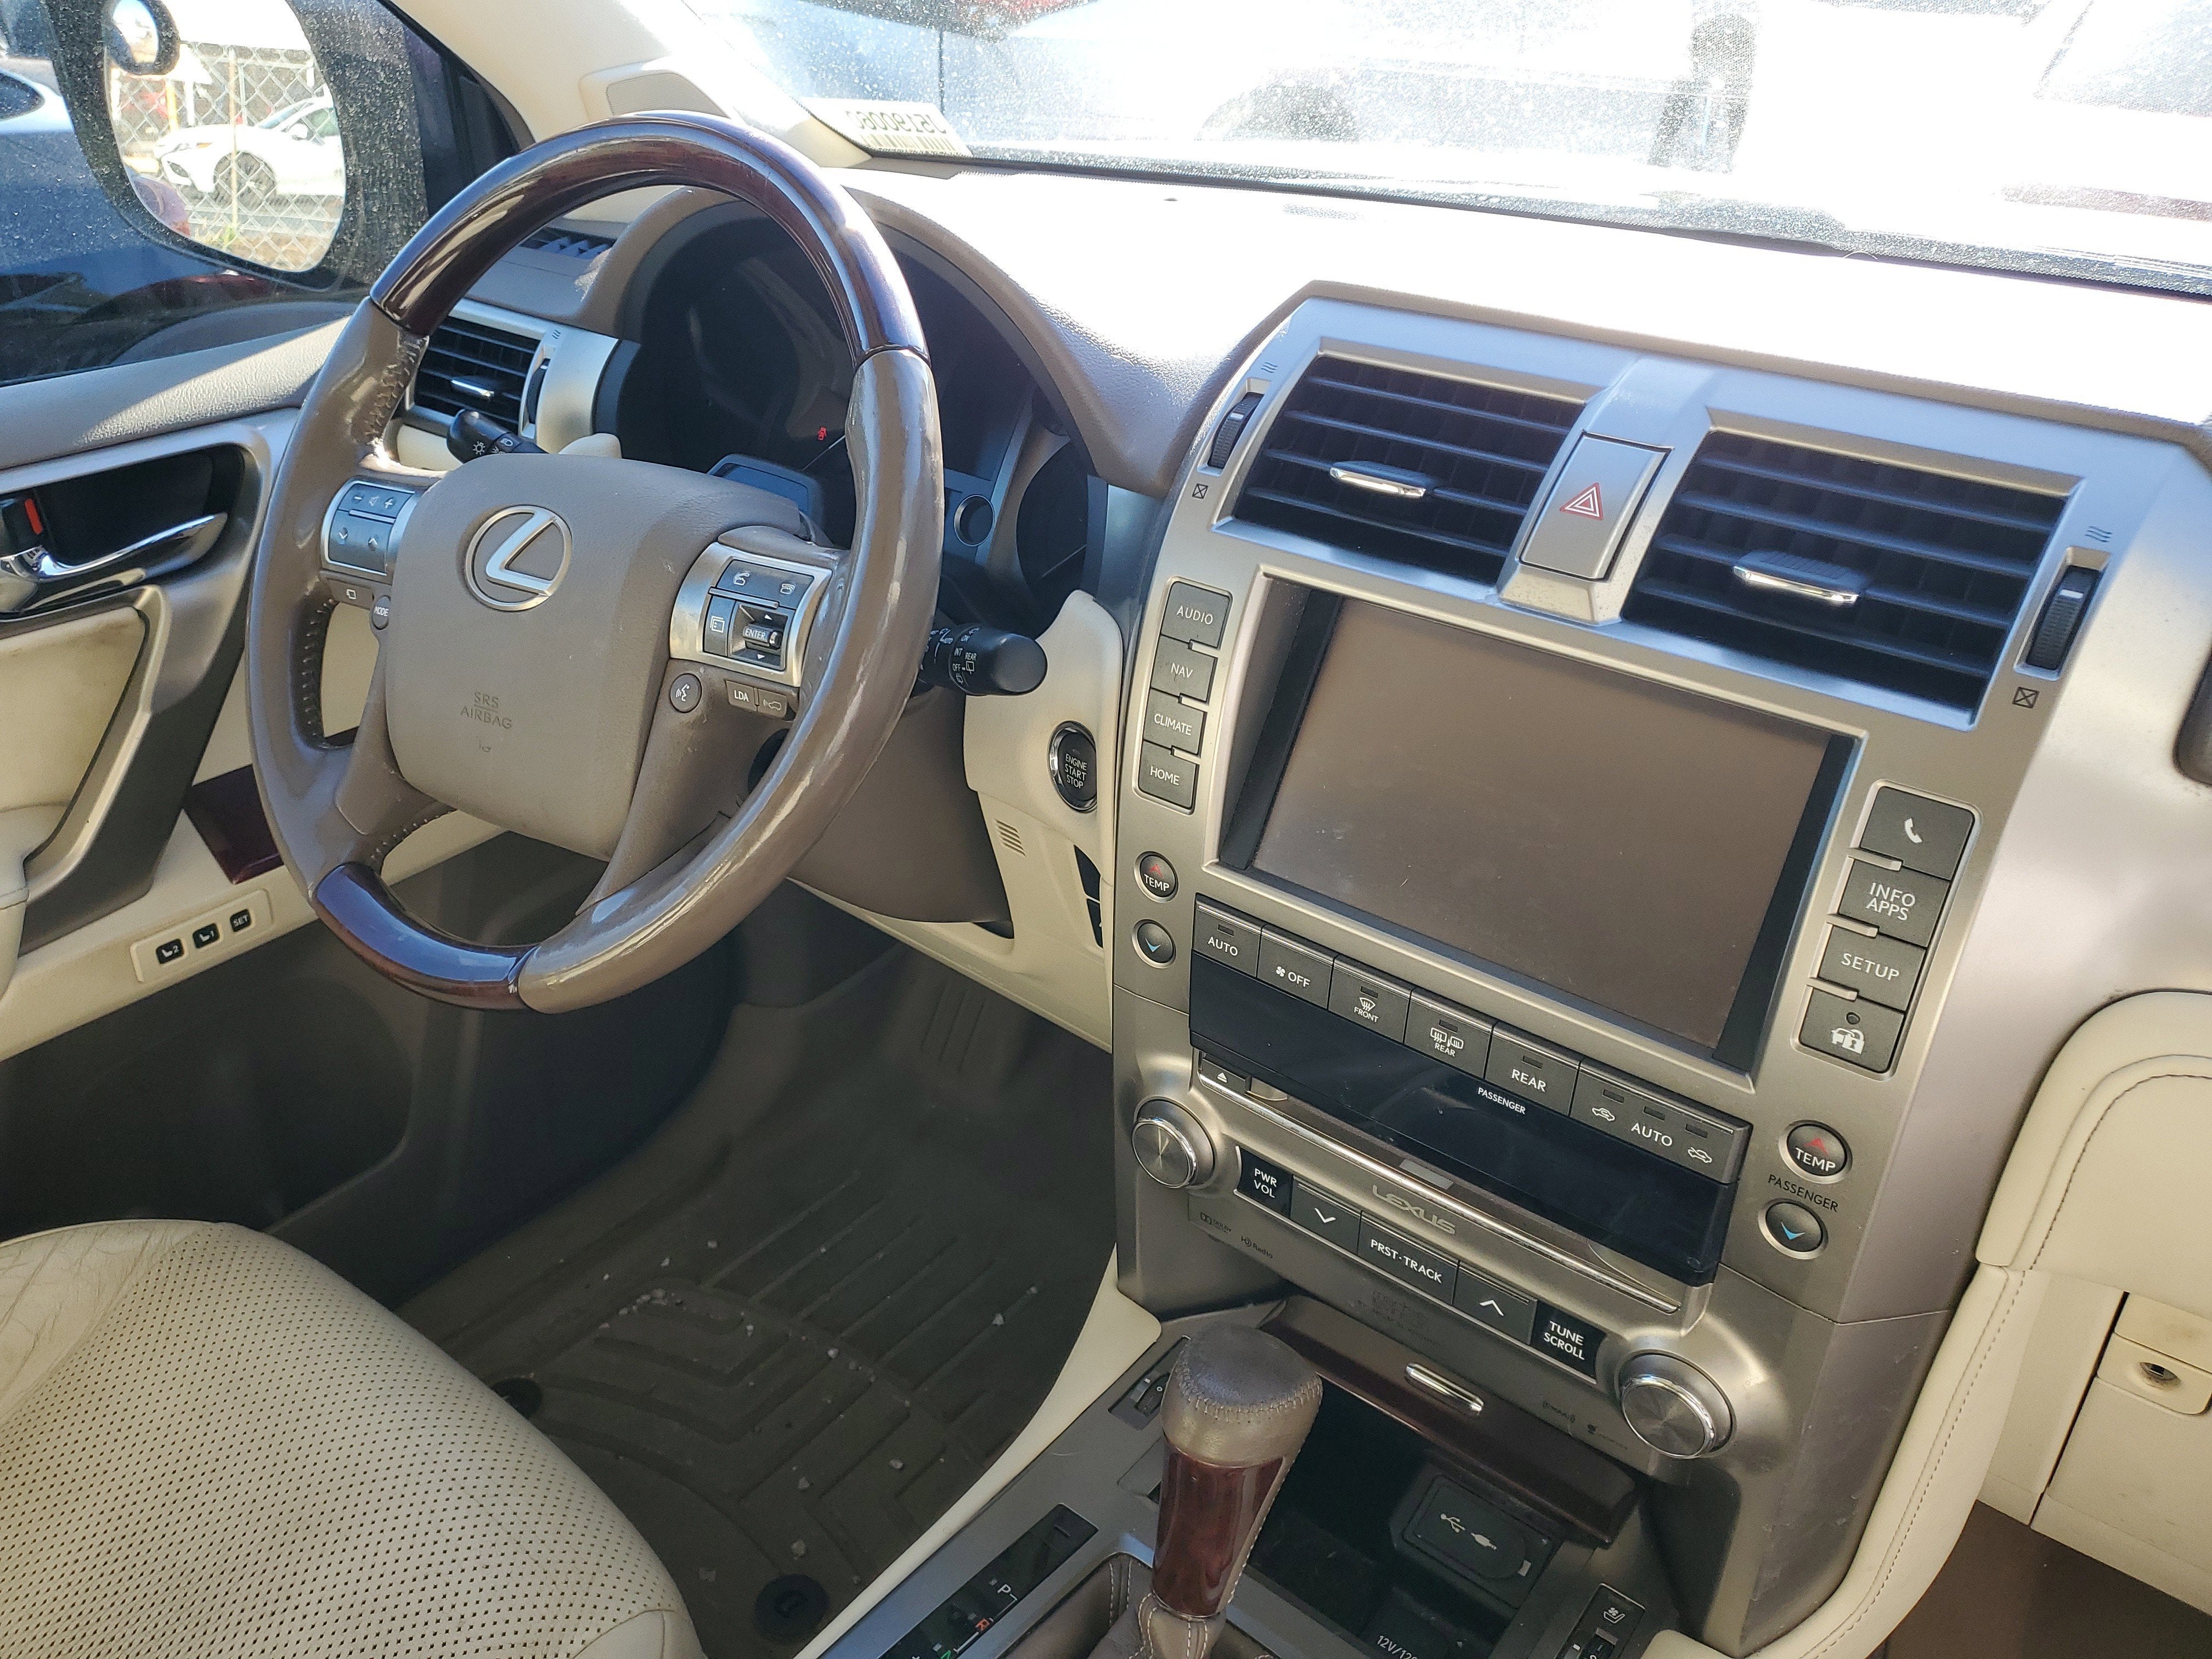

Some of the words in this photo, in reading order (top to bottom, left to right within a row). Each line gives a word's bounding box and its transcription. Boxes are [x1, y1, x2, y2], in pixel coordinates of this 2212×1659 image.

[374, 606, 389, 617] MODE
[1176, 605, 1214, 625] AUDIO
[745, 628, 767, 639] ENTER
[954, 647, 963, 656] INT
[965, 652, 977, 661] REAR
[952, 663, 961, 672] OFF
[1171, 664, 1194, 679] NAV
[474, 691, 499, 709] SRS
[734, 690, 749, 702] LDA
[461, 705, 512, 729] AIRBAG
[1154, 713, 1193, 736] CLIMATE
[1065, 753, 1087, 771] ENGINE
[1064, 763, 1087, 782] START
[1066, 775, 1084, 789] STOP
[1150, 766, 1180, 786] HOME
[1144, 874, 1170, 892] TEMP
[1869, 882, 1916, 907] INFO
[1866, 896, 1909, 921] APPS
[233, 914, 249, 926] SET
[1207, 936, 1238, 957] AUTO
[1841, 953, 1900, 981] SETUP
[1288, 970, 1311, 988] OFF
[1353, 1006, 1379, 1023] FRONT
[1434, 1042, 1456, 1057] REAR
[1511, 1068, 1547, 1093] REAR
[1477, 1086, 1526, 1115] PASSENGER
[1630, 1122, 1673, 1148] AUTO
[1795, 1147, 1836, 1172] TEMP
[1254, 1167, 1278, 1188] PWR
[1254, 1180, 1276, 1199] VOL
[1768, 1173, 1839, 1212] PASSENGER
[1372, 1184, 1455, 1235] LEXUS
[1253, 1243, 1273, 1259] Radio
[1549, 1320, 1585, 1346] TUNE
[1543, 1331, 1585, 1361] SCROLL
[1377, 1635, 1418, 1659] 12V/12
